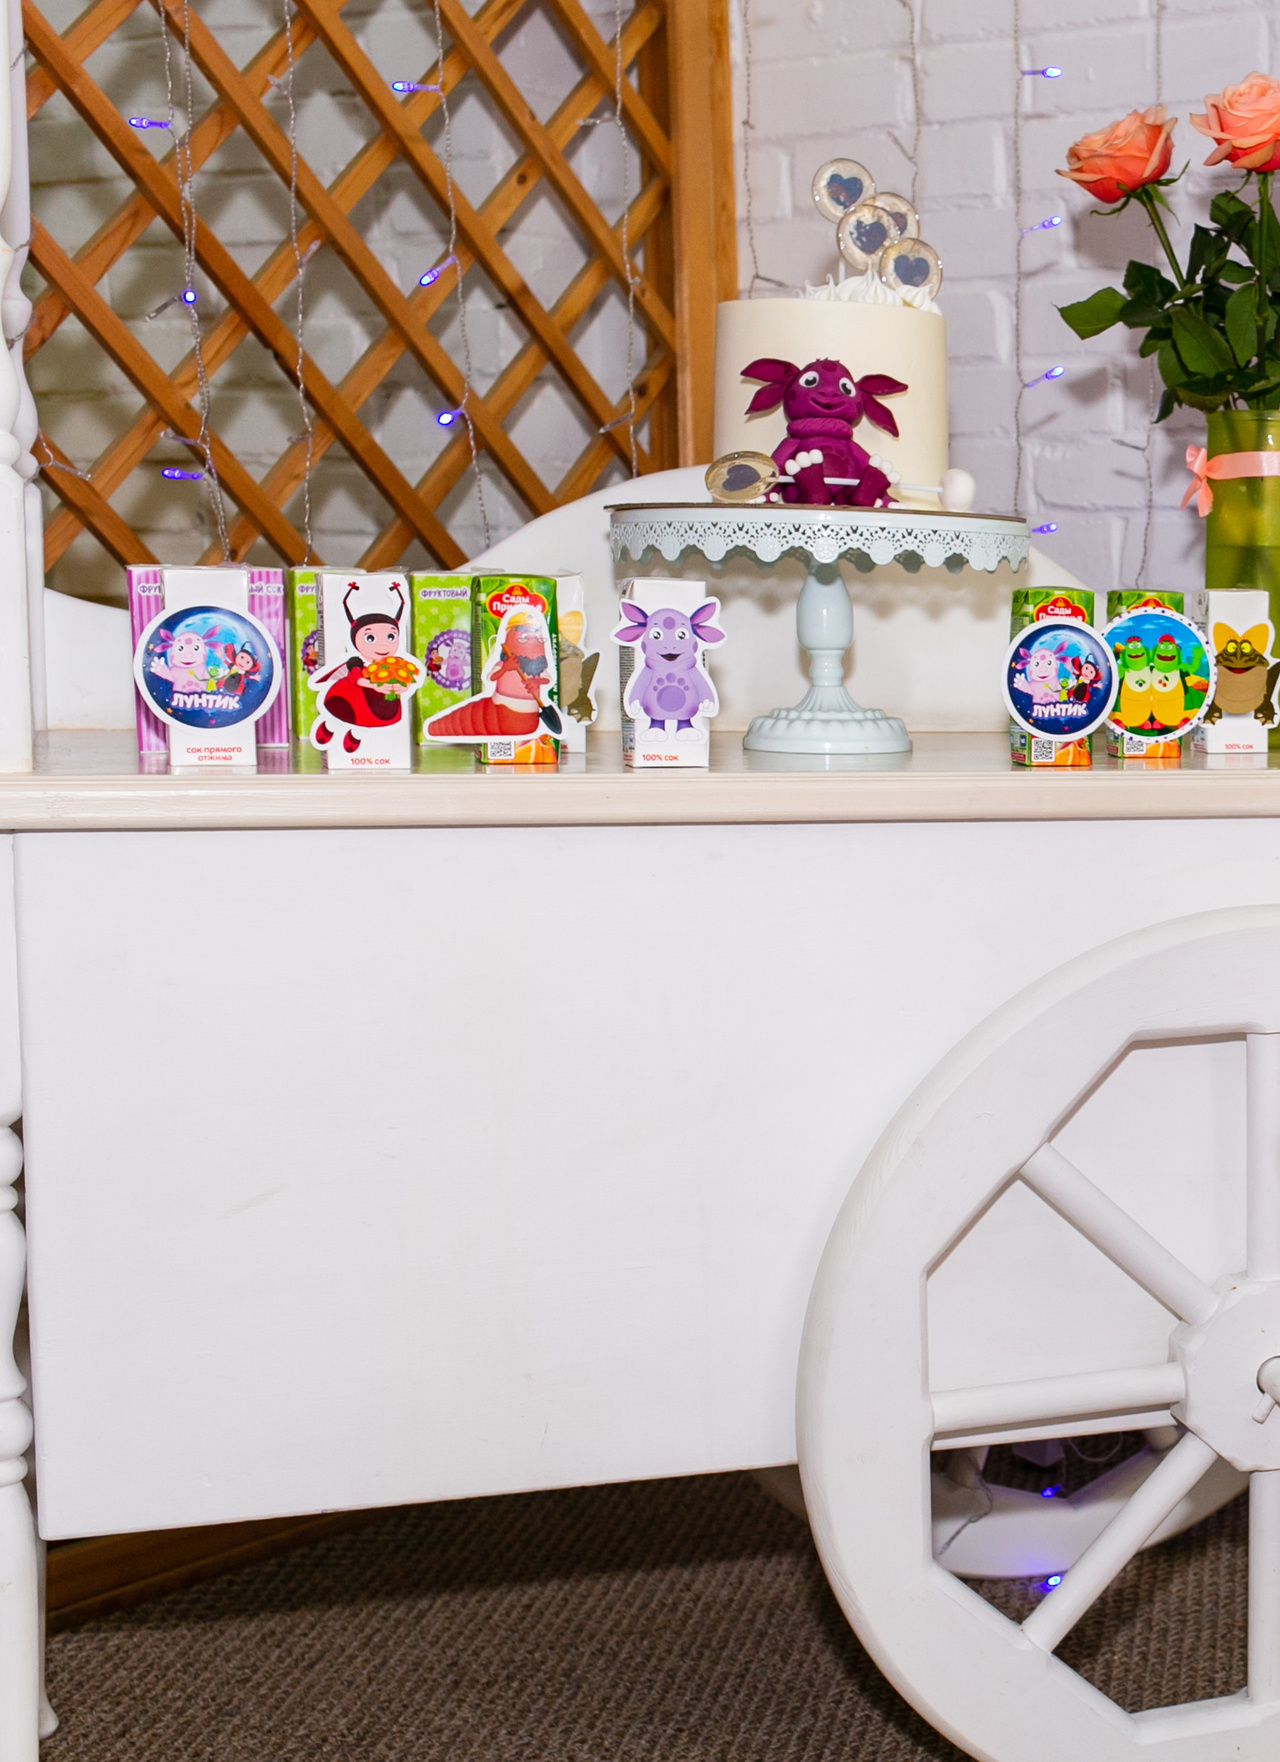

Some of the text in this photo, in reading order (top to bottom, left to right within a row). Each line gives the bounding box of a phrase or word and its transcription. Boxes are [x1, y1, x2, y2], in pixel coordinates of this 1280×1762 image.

[421, 587, 467, 598] ФРУКТОВЫЙ
[502, 593, 529, 604] Сады
[1047, 605, 1072, 615] Сады
[171, 693, 240, 710] ЛУНТИК
[1032, 703, 1087, 718] ЛУНТИК
[203, 746, 242, 755] прямого
[351, 757, 373, 766] 100%
[642, 754, 662, 762] 100%
